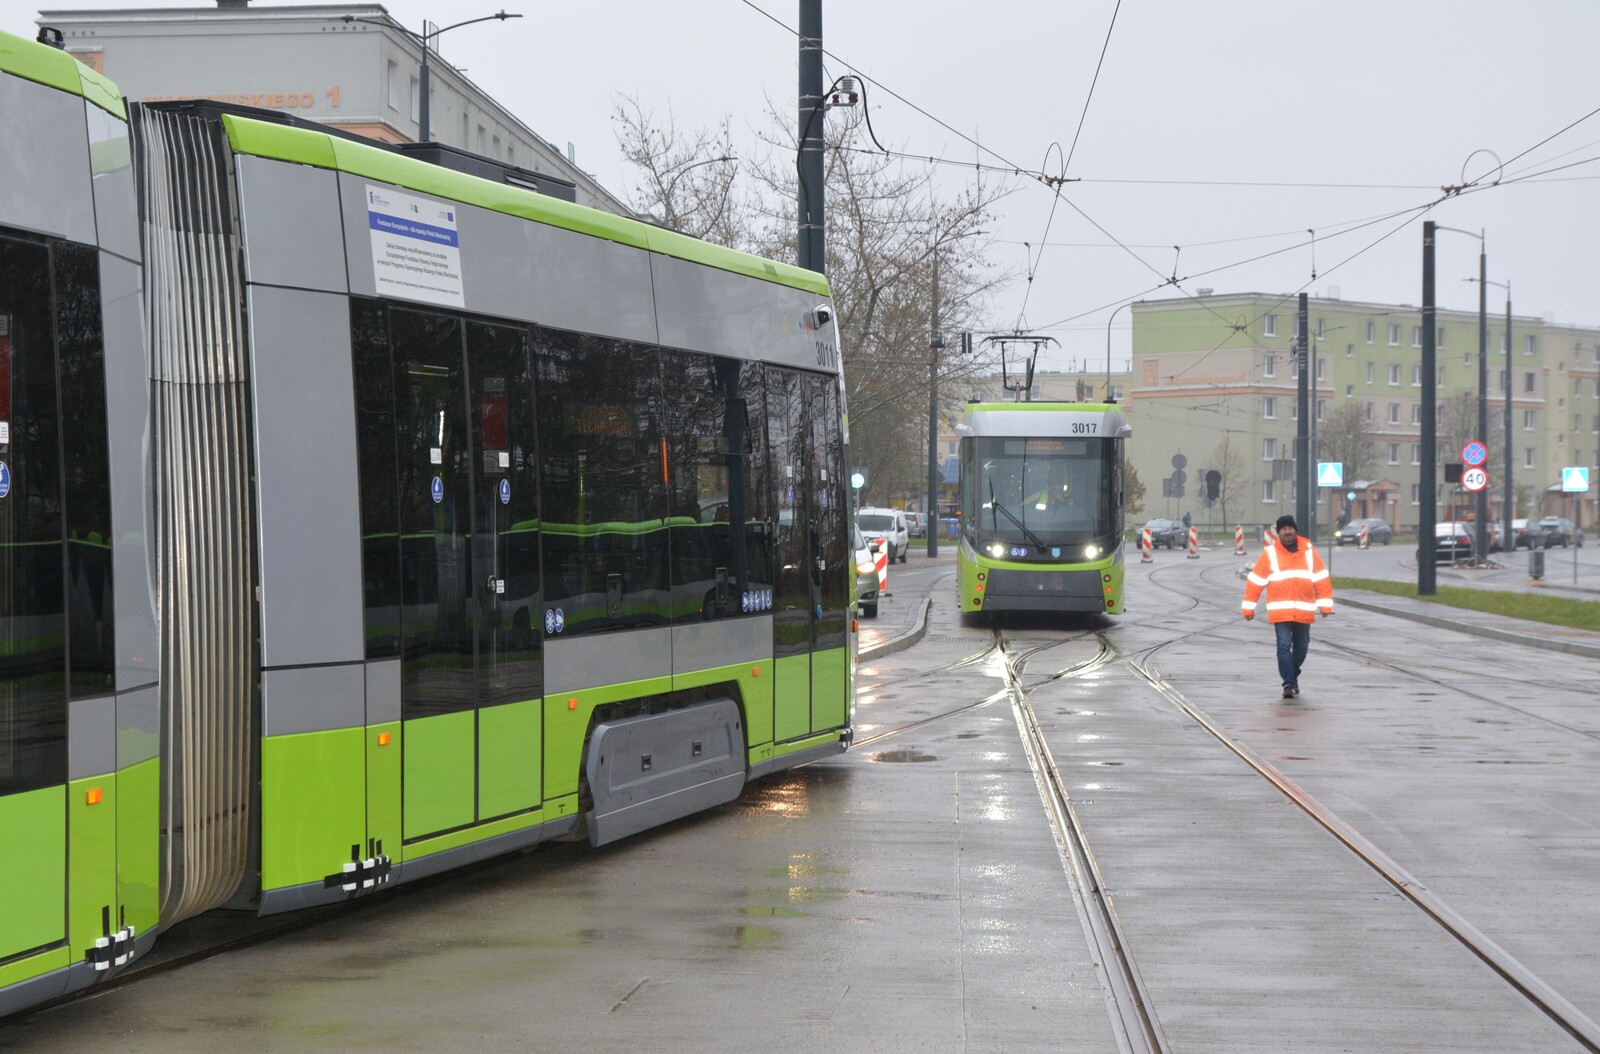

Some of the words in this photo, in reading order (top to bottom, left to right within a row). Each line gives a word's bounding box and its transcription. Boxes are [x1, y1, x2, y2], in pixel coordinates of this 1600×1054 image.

[325, 85, 340, 109] 1
[816, 341, 834, 368] 3011
[1072, 423, 1097, 434] 3017
[1466, 472, 1485, 485] 40
